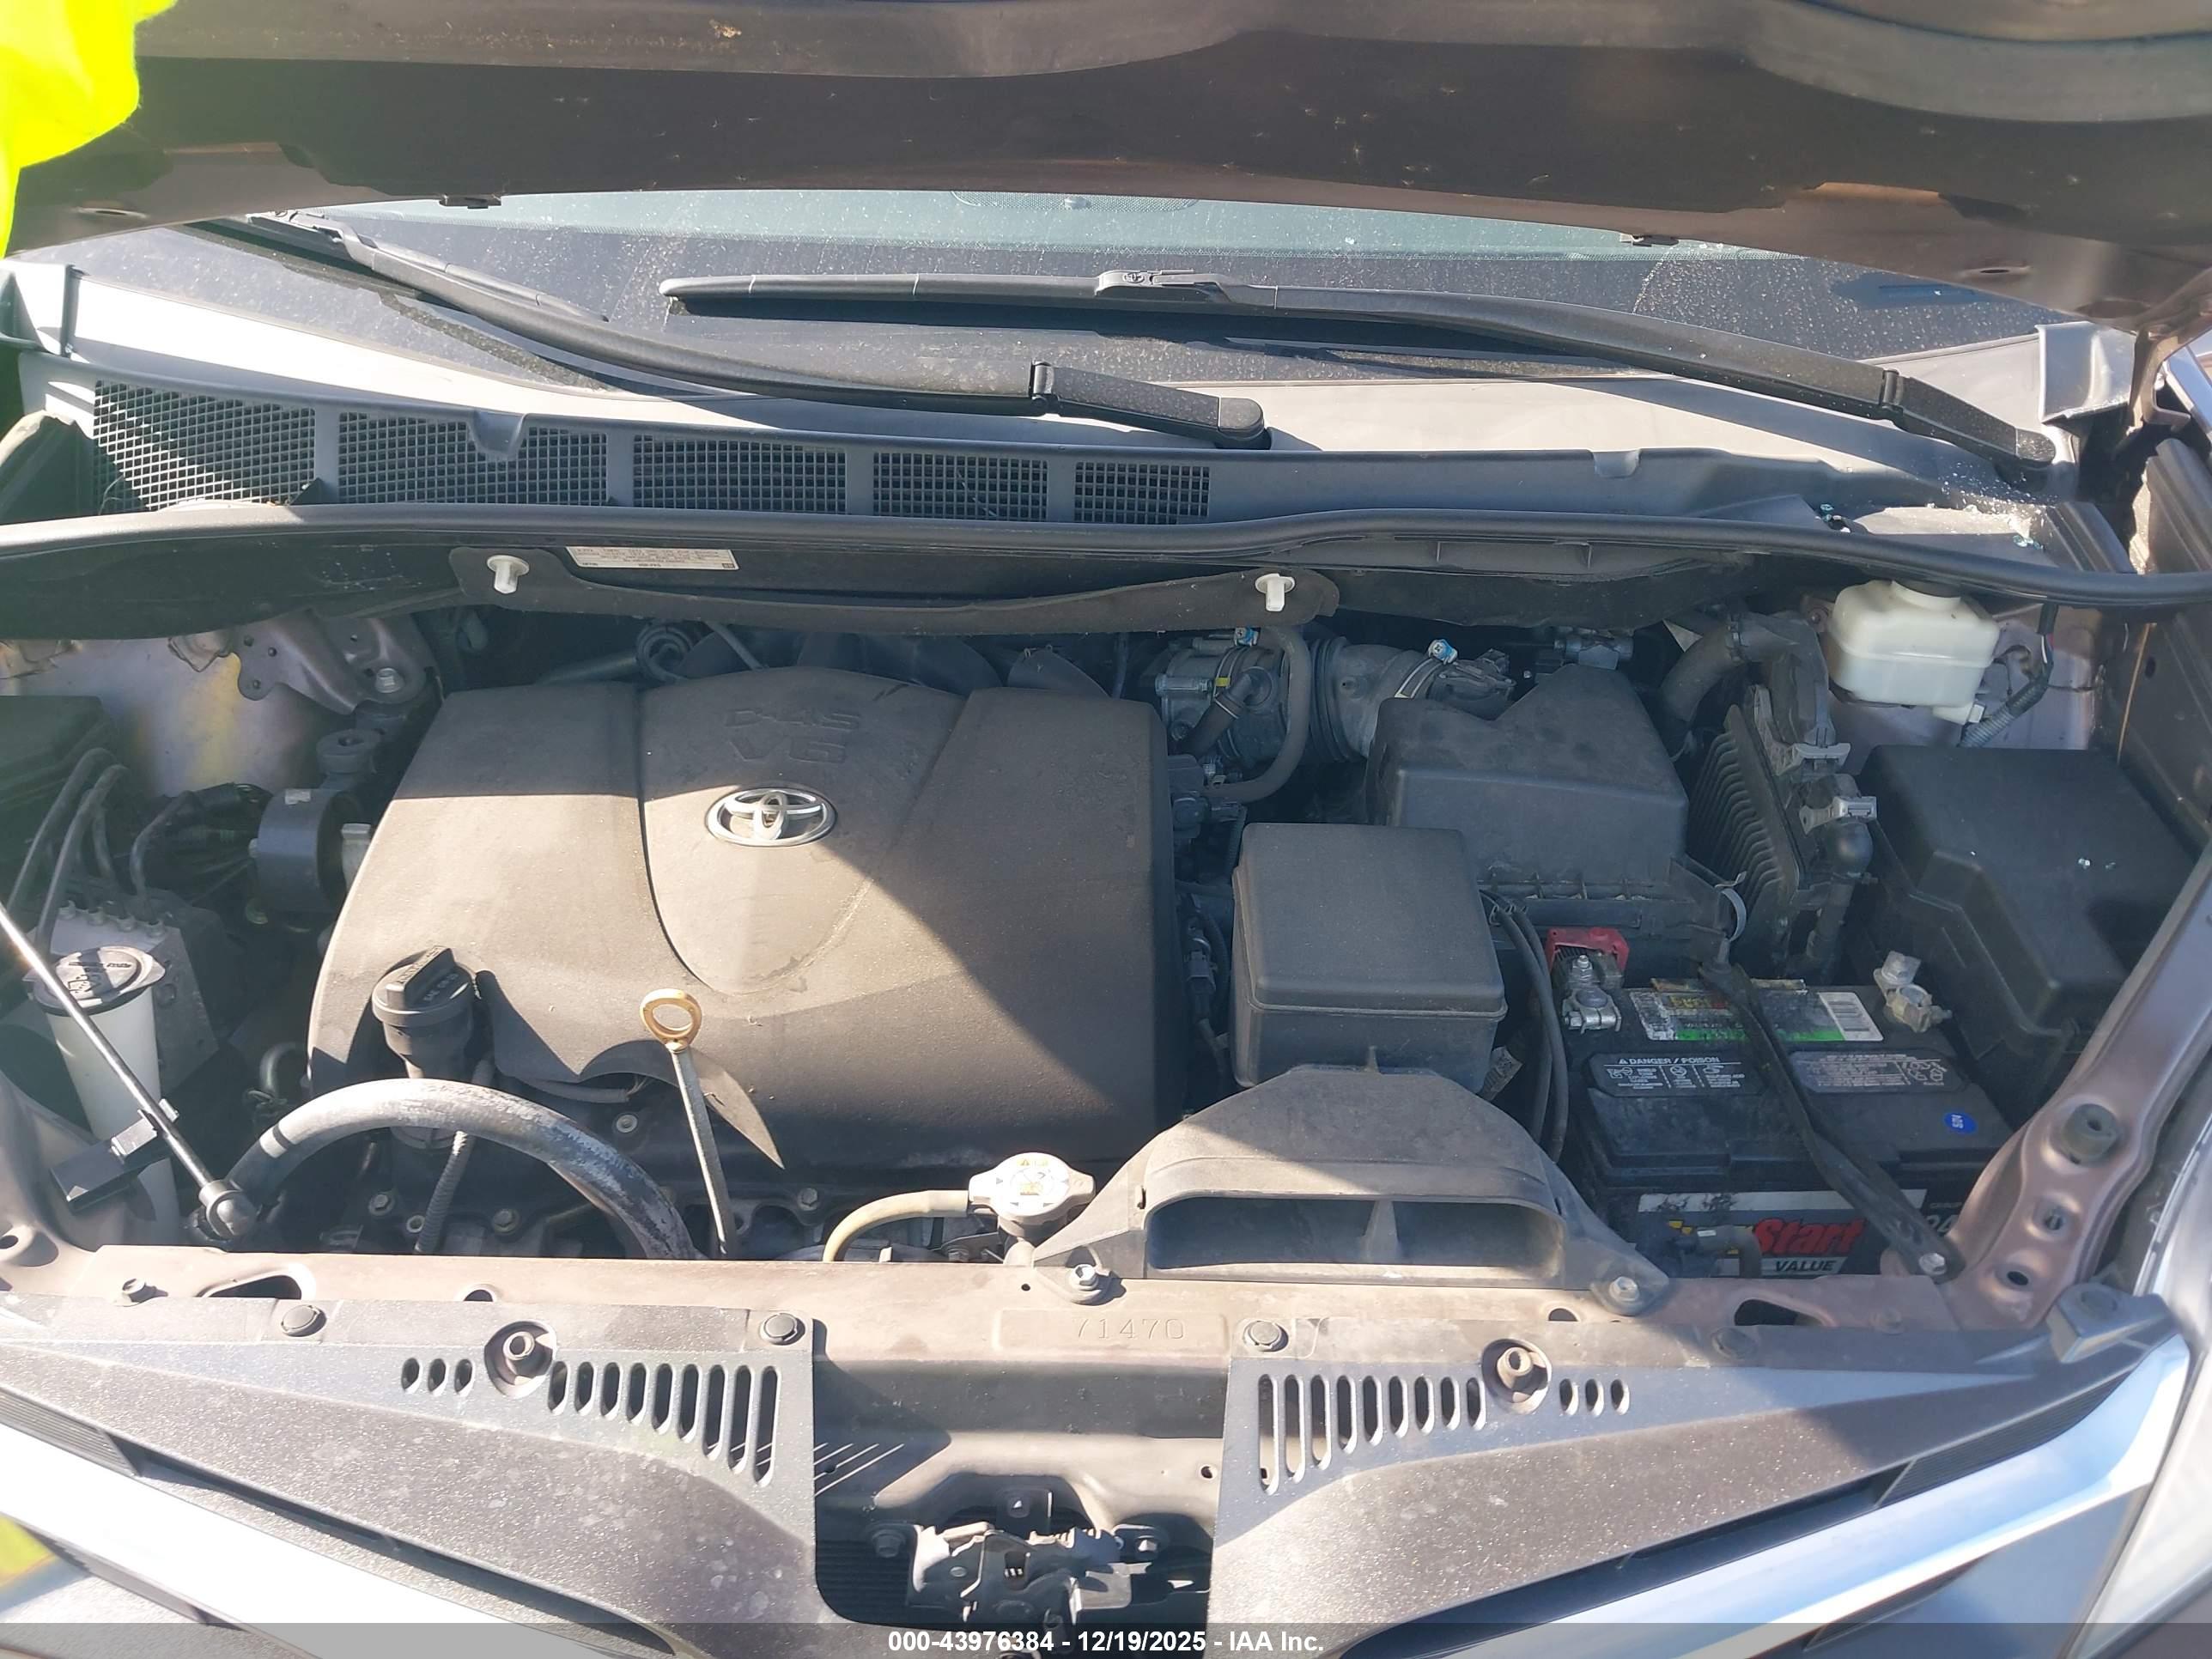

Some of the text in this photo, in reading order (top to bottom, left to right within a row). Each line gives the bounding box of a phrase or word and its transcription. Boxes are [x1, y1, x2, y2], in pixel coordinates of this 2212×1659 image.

[1680, 1055, 1720, 1064] POISON
[1753, 1216, 1868, 1255] Start
[1774, 1260, 1837, 1273] VALUE
[1074, 1317, 1184, 1340] 71470
